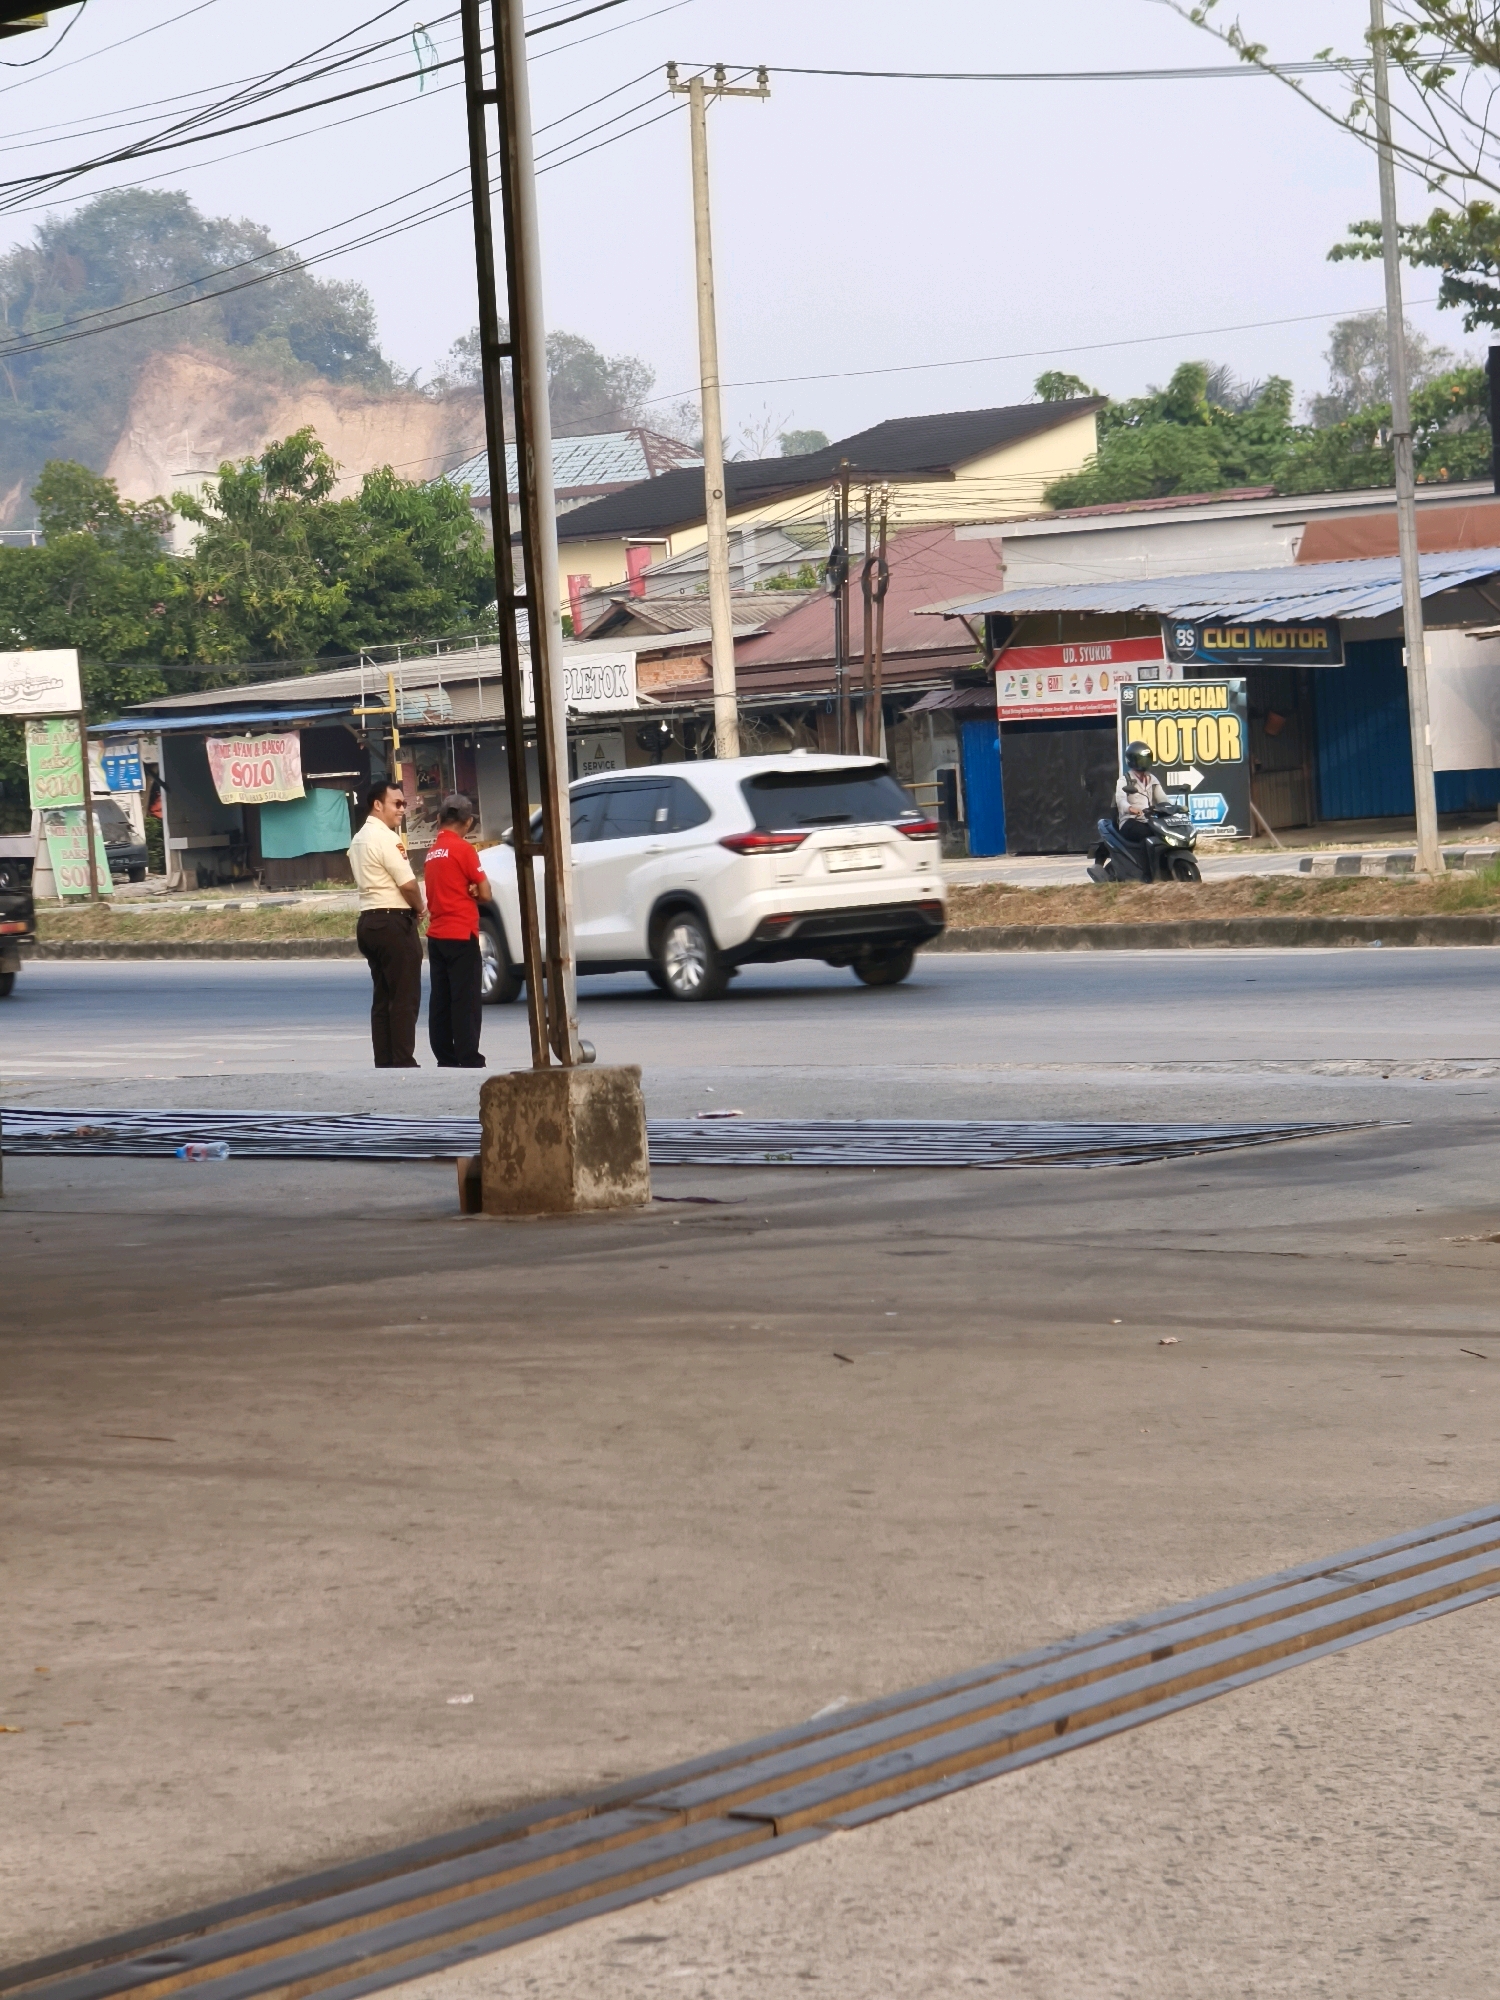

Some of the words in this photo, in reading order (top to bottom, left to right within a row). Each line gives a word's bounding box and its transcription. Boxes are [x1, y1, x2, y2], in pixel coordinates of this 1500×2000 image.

[1203, 627, 1250, 649] CUCI
[1254, 627, 1328, 649] MOTOR
[1063, 647, 1078, 664] UD.
[1080, 644, 1113, 663] SYUKUR
[1138, 686, 1228, 711] PENCUCIAN
[233, 741, 253, 757] AYAM
[254, 742, 260, 756] &
[262, 739, 285, 755] BAKSO
[1128, 716, 1241, 763] MOTOR
[231, 760, 275, 788] SOLO
[582, 760, 616, 771] SERVICE
[35, 772, 81, 799] SOLO
[1192, 797, 1220, 809] TUTUP
[61, 849, 89, 860] BAKS
